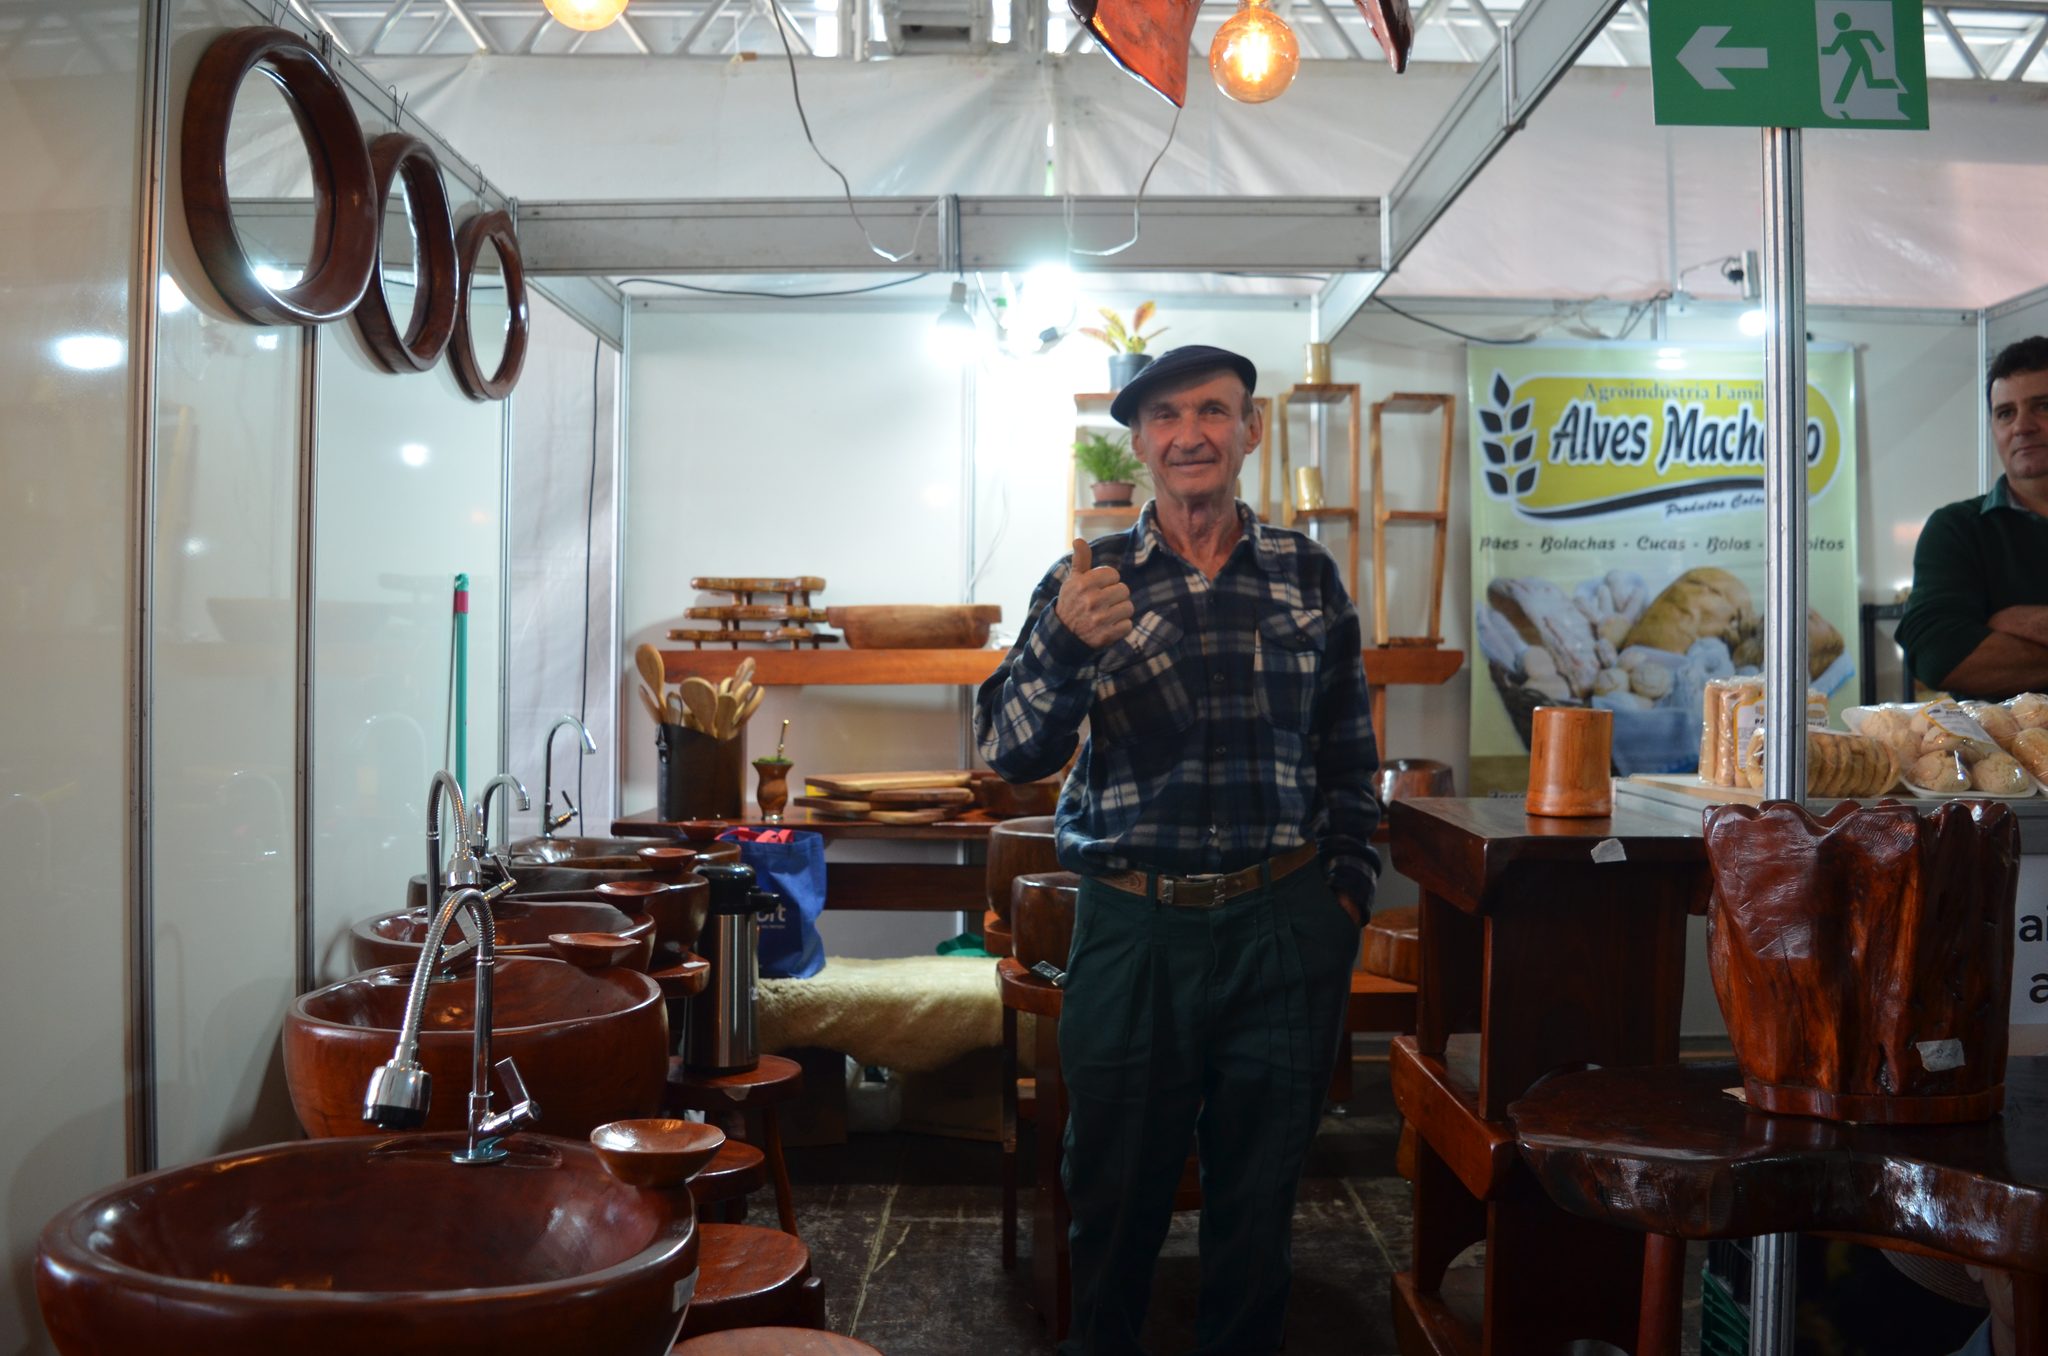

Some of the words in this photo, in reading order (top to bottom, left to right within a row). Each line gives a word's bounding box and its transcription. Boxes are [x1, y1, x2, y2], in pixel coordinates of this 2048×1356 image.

[1716, 383, 1765, 400] Famil
[1550, 403, 1648, 462] Alves
[1657, 405, 1821, 471] Macho
[1540, 535, 1616, 554] Bolachas
[1636, 535, 1686, 551] Cucas
[1705, 535, 1751, 554] Bolos
